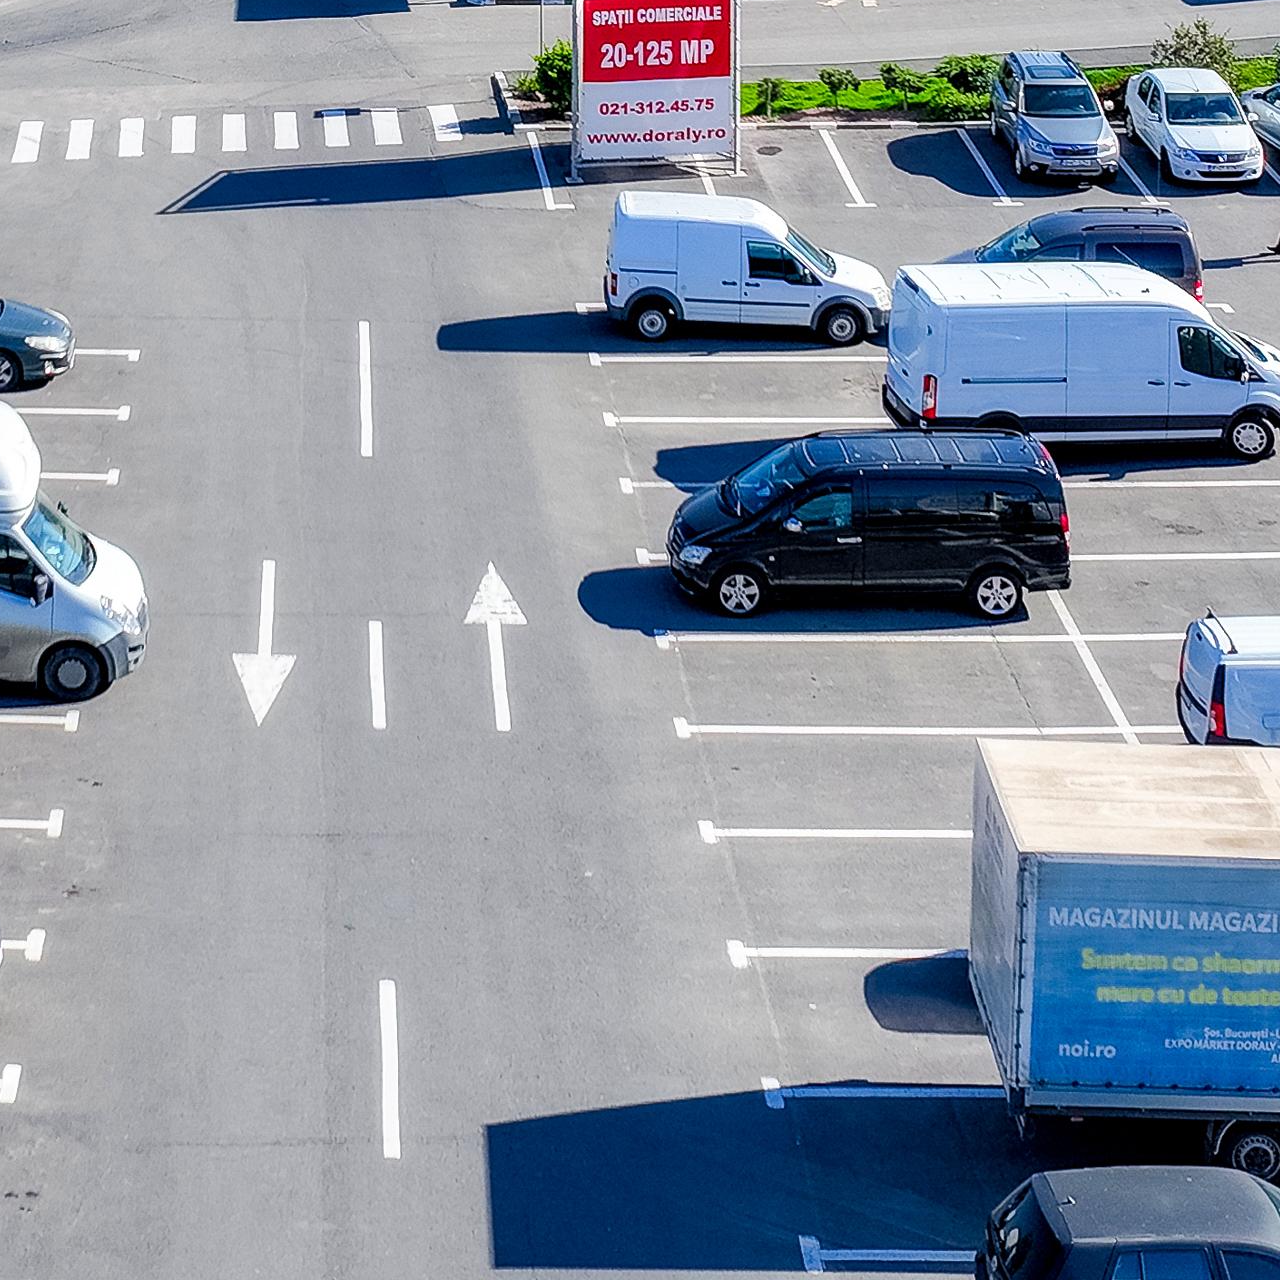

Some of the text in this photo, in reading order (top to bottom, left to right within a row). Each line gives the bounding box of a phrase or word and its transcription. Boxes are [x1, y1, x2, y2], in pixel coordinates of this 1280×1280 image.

[637, 6, 723, 23] COMERCIALE
[600, 38, 715, 69] 20-125 MP
[598, 98, 715, 117] 021-312.45.75
[587, 128, 727, 146] www.doraly.ro
[1048, 906, 1185, 931] MAGAZINUL
[1058, 1039, 1118, 1059] noi.ro
[1164, 1038, 1193, 1050] EXPO
[1194, 1039, 1236, 1051] MARKET
[1236, 1040, 1278, 1052] DORALY
